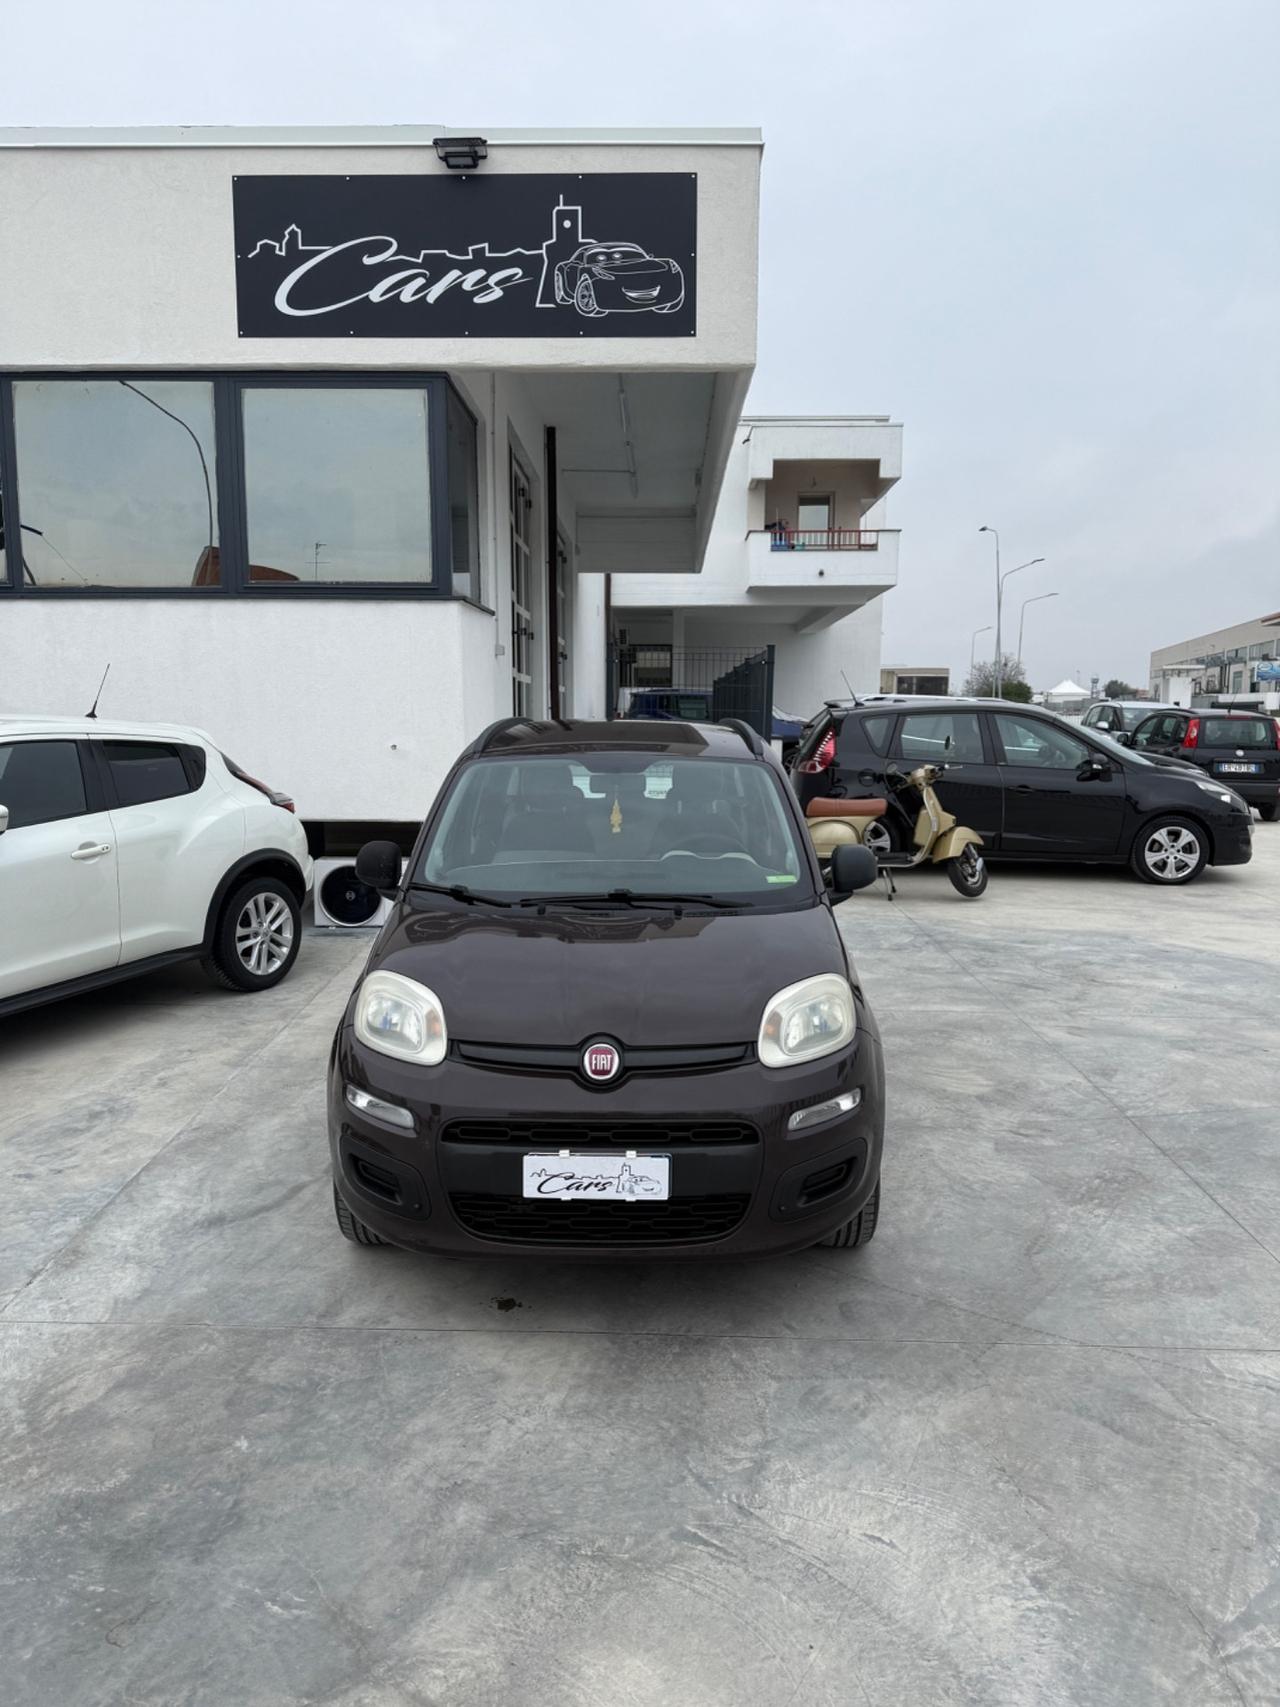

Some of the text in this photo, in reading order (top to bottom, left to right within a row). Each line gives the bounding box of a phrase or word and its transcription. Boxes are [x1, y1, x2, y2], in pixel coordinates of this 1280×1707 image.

[274, 235, 534, 316] Cars
[592, 1054, 612, 1071] FIAT
[537, 1172, 613, 1194] Cars
